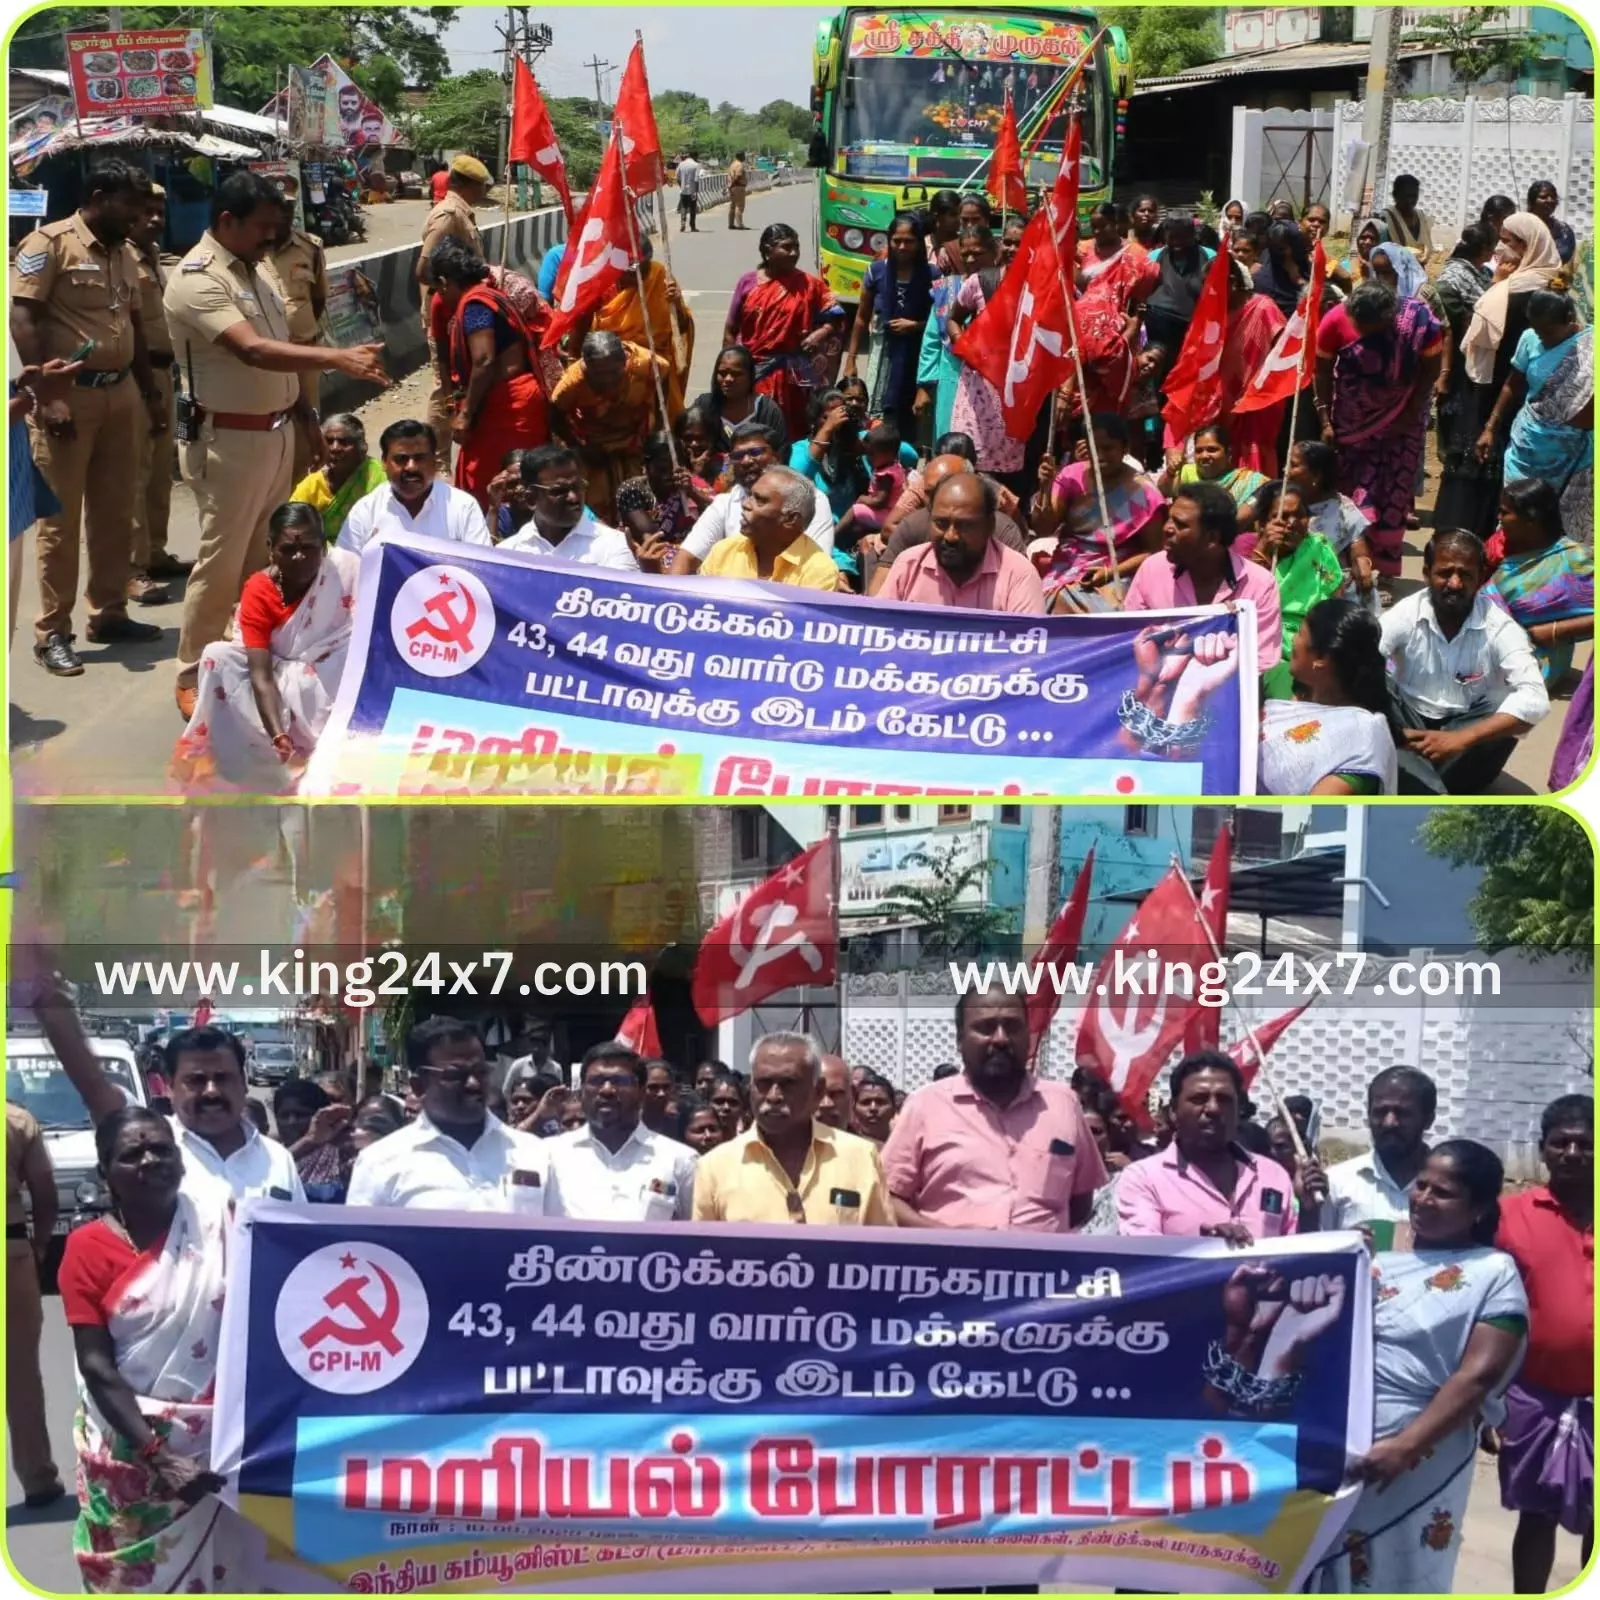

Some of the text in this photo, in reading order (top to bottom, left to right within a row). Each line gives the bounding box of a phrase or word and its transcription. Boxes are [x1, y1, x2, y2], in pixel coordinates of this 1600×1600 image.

[993, 28, 1081, 59] முருகன்
[552, 587, 1048, 657] திண்டுக்கல் மாநகராட்சி
[408, 640, 459, 664] CPI-M
[507, 622, 1089, 703] 43, 44 வது வார்டு மக்களுக்கு
[525, 670, 740, 726] பட்டாவுக்கு
[751, 698, 865, 734] இடம்
[877, 707, 1007, 746] கேட்டு
[506, 1245, 1122, 1301] திண்டுக்கல் மாநகராட்சி
[447, 1303, 1169, 1354] 43, 44 வது வார்டு மக்களுக்கு
[308, 1350, 381, 1372] CPI-M
[484, 1358, 761, 1403] பட்டாவுக்கு
[776, 1359, 914, 1398] இடம்
[928, 1362, 1077, 1406] கேட்டு
[345, 1433, 1251, 1530] மறியல் போராட்டம்
[350, 1560, 436, 1594] இந்திய
[444, 1543, 588, 1582] கம்யூனிஸ்ட்
